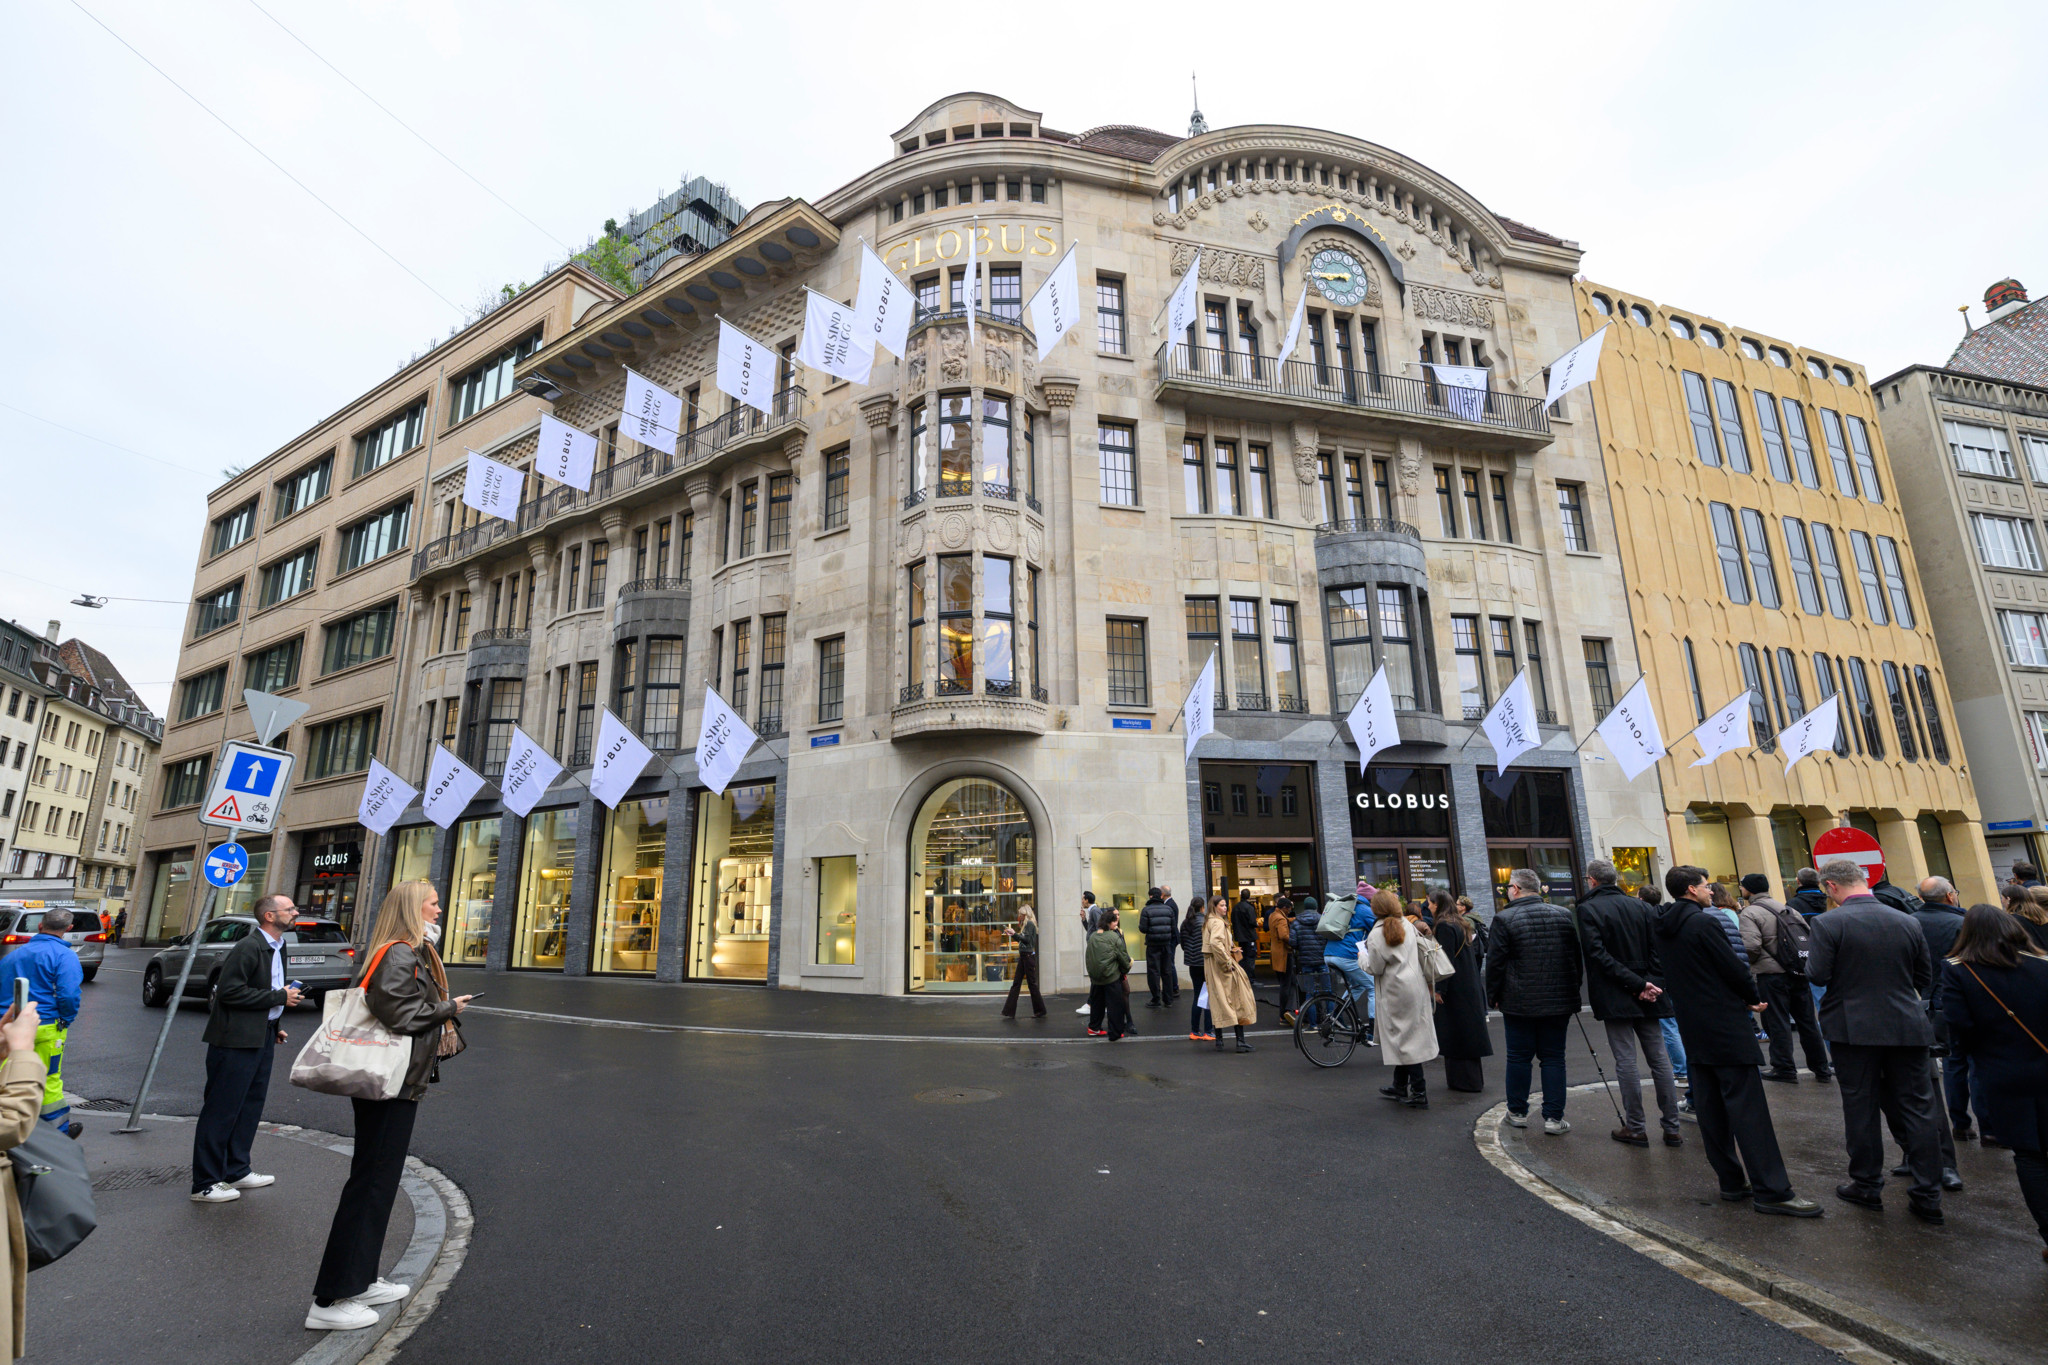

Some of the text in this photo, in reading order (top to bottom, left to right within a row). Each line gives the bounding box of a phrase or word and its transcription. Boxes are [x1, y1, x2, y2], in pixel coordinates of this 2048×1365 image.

[884, 224, 1056, 274] GLOBUS
[874, 278, 892, 333] GLOBUS
[822, 311, 842, 368] MIR SIND
[835, 324, 852, 366] ZRUGG
[741, 344, 752, 395] GLOBUS
[640, 390, 654, 438] MIR SIND
[650, 400, 661, 437] ZRUGG
[559, 432, 572, 478] GLOBUS
[484, 466, 494, 488] SIND
[490, 474, 502, 506] ZRUGG
[705, 713, 726, 741] SIND
[512, 748, 532, 774] SIND
[704, 726, 730, 768] ZRUGG
[370, 776, 390, 798] SIND
[428, 766, 460, 807] LOBUS
[508, 760, 536, 794] ZRUGG
[367, 787, 394, 816] ZRUGG
[1356, 792, 1450, 808] GLOBUS
[314, 853, 348, 866] GLOBUS
[962, 858, 982, 866] MCM
[326, 1030, 389, 1047] Santoni
